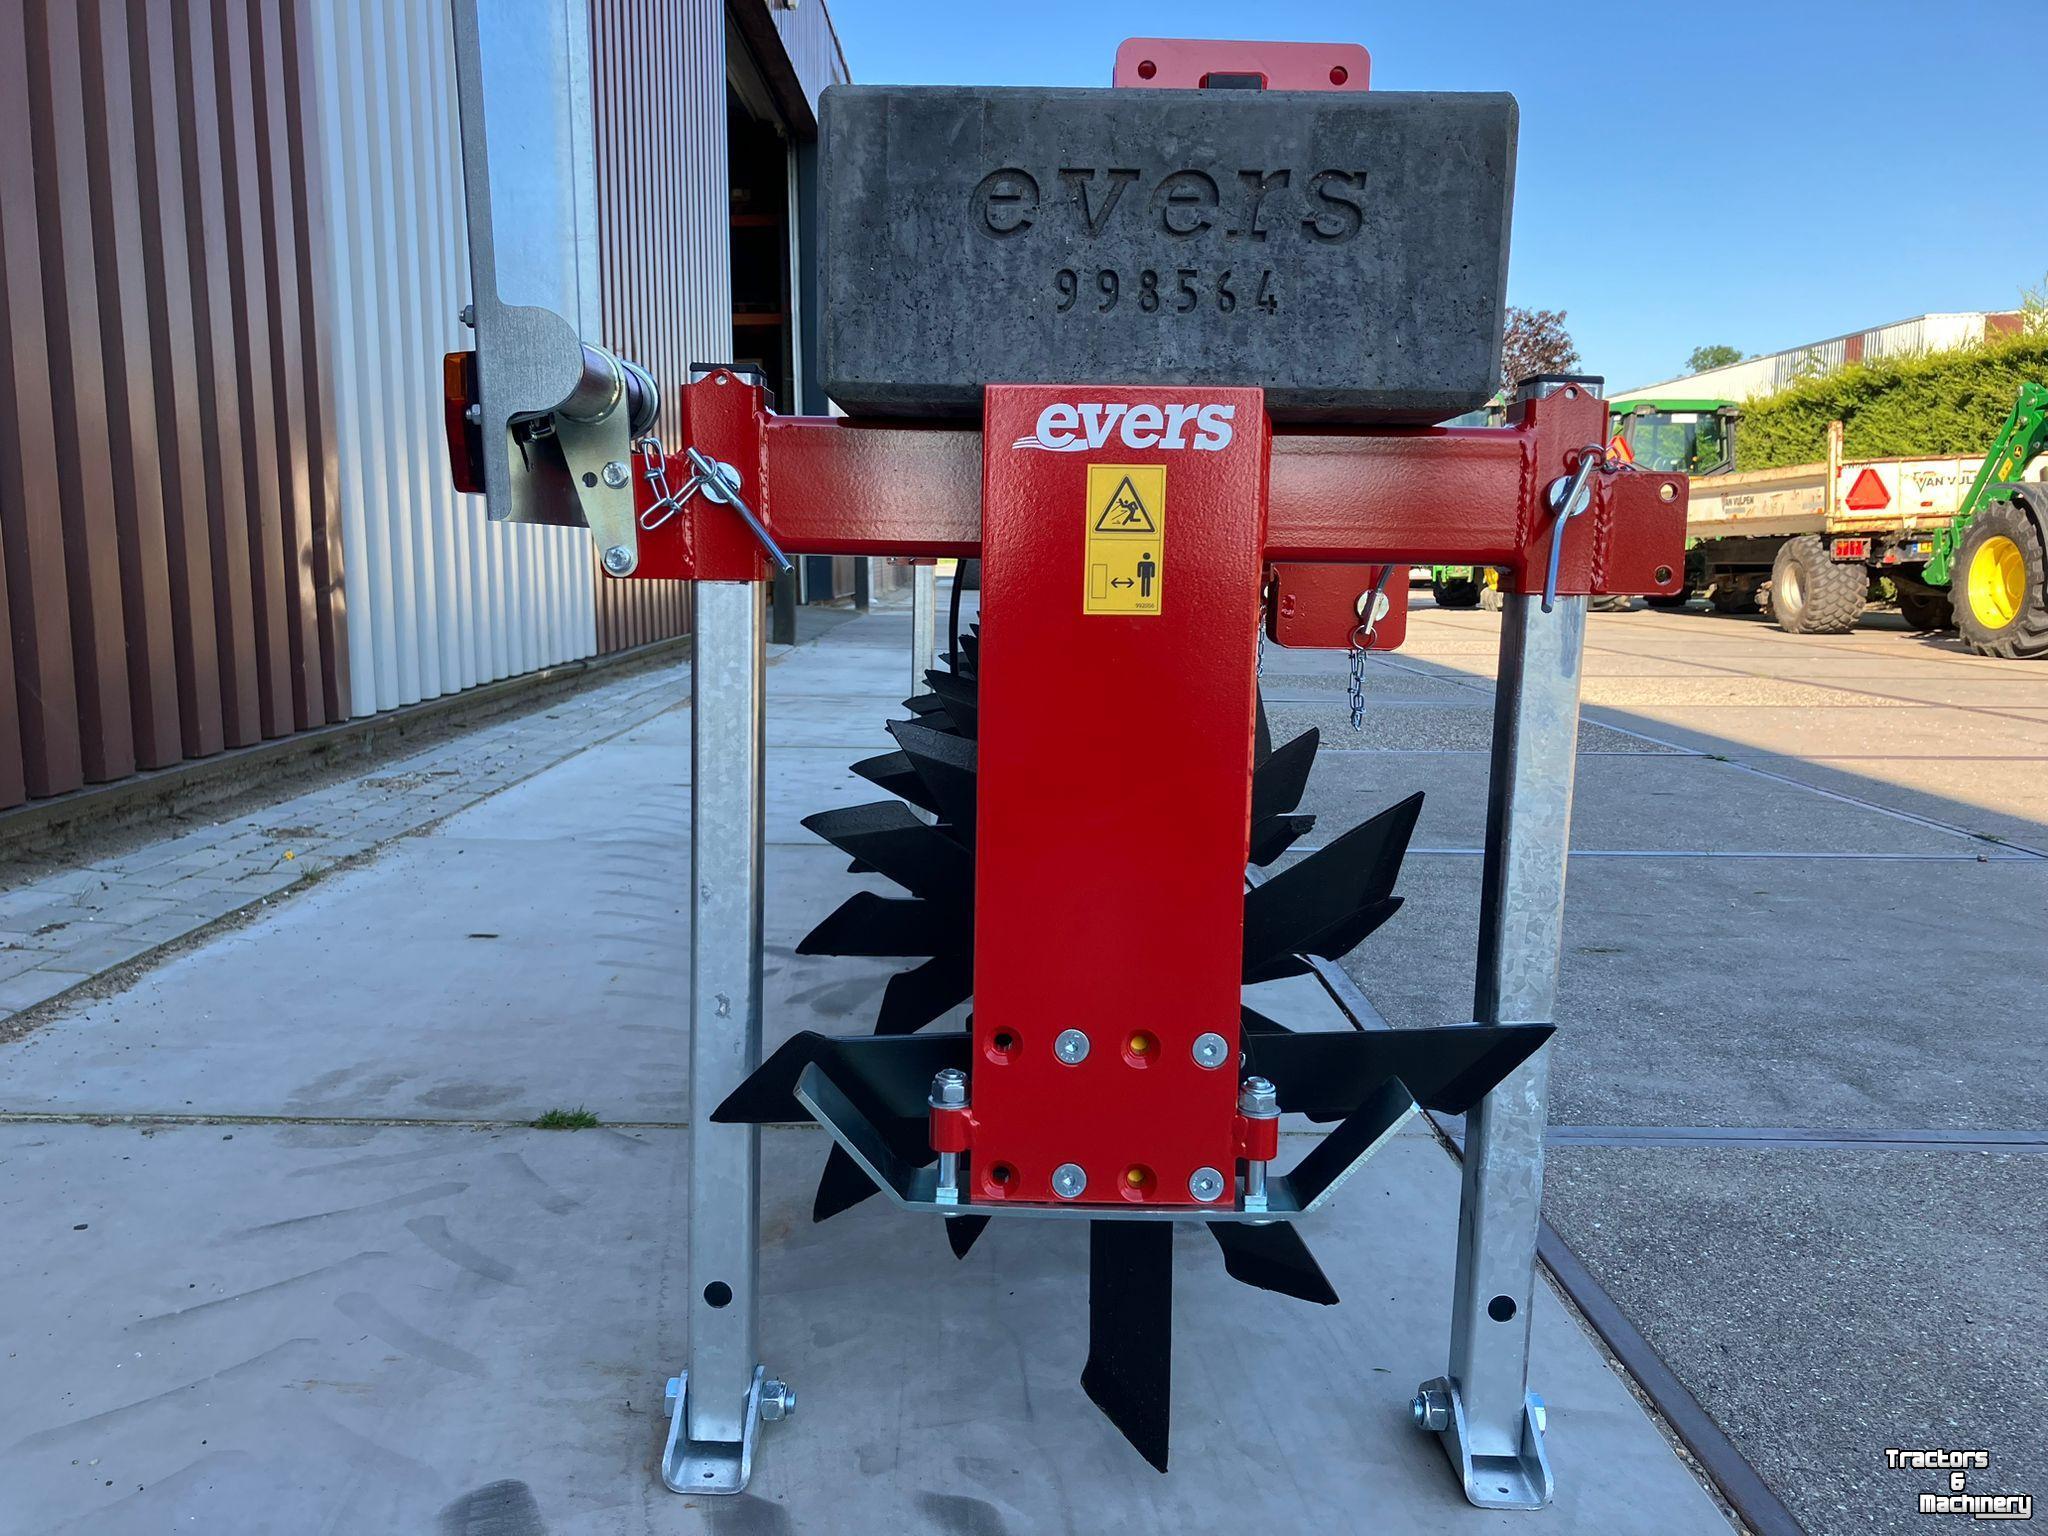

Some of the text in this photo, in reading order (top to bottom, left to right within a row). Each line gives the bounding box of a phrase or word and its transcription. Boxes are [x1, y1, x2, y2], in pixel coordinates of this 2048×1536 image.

[967, 166, 1368, 245] evers
[1055, 268, 1278, 315] 998564
[1034, 402, 1236, 452] evers
